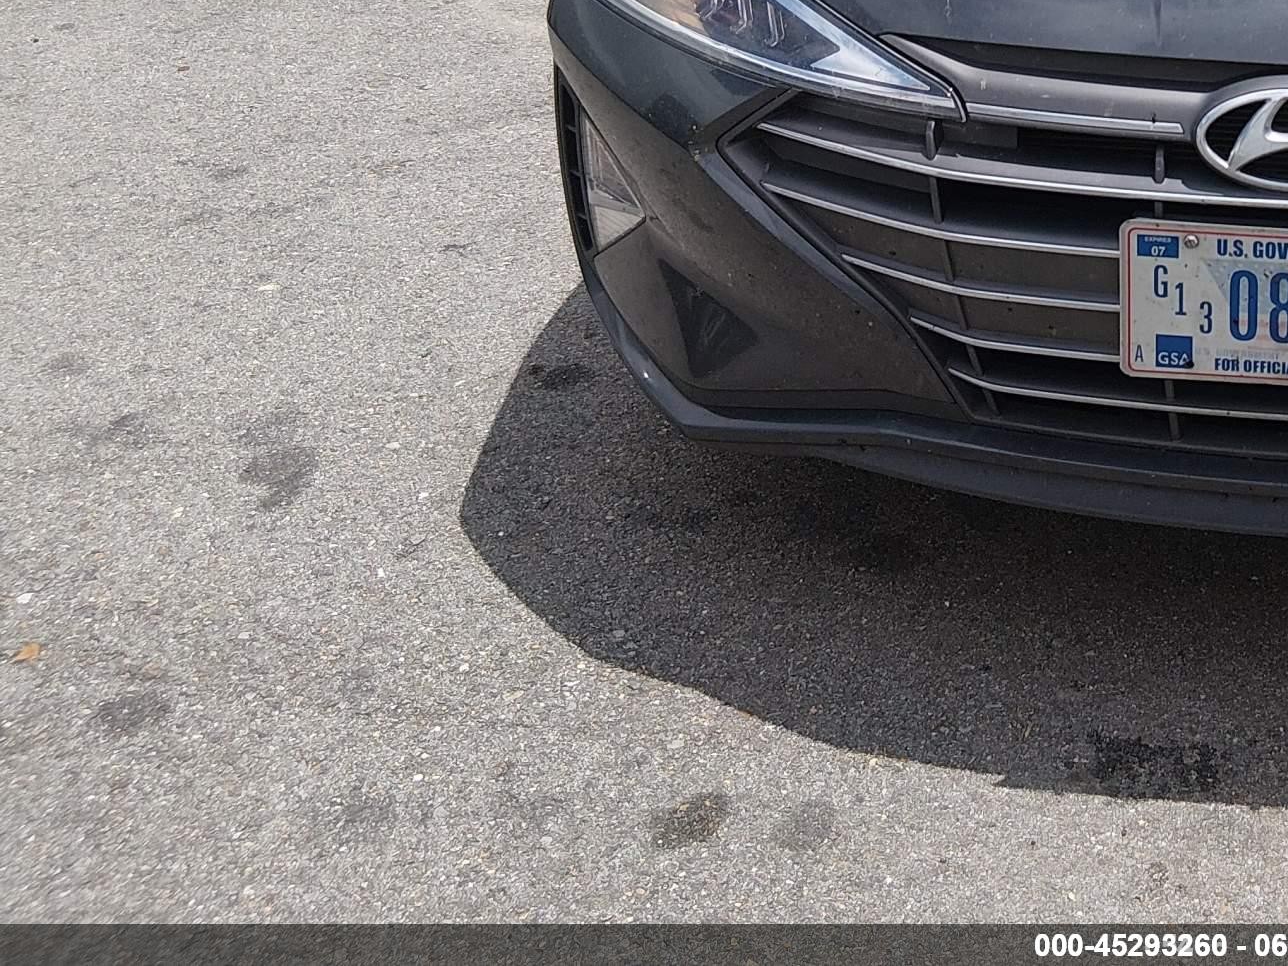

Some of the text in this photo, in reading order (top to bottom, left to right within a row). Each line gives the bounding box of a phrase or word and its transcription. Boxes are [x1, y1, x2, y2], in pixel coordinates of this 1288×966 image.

[1151, 245, 1166, 257] 07
[1217, 239, 1246, 260] U.S.
[1134, 344, 1144, 363] A
[1157, 351, 1191, 366] GSA
[1214, 357, 1240, 372] FOR
